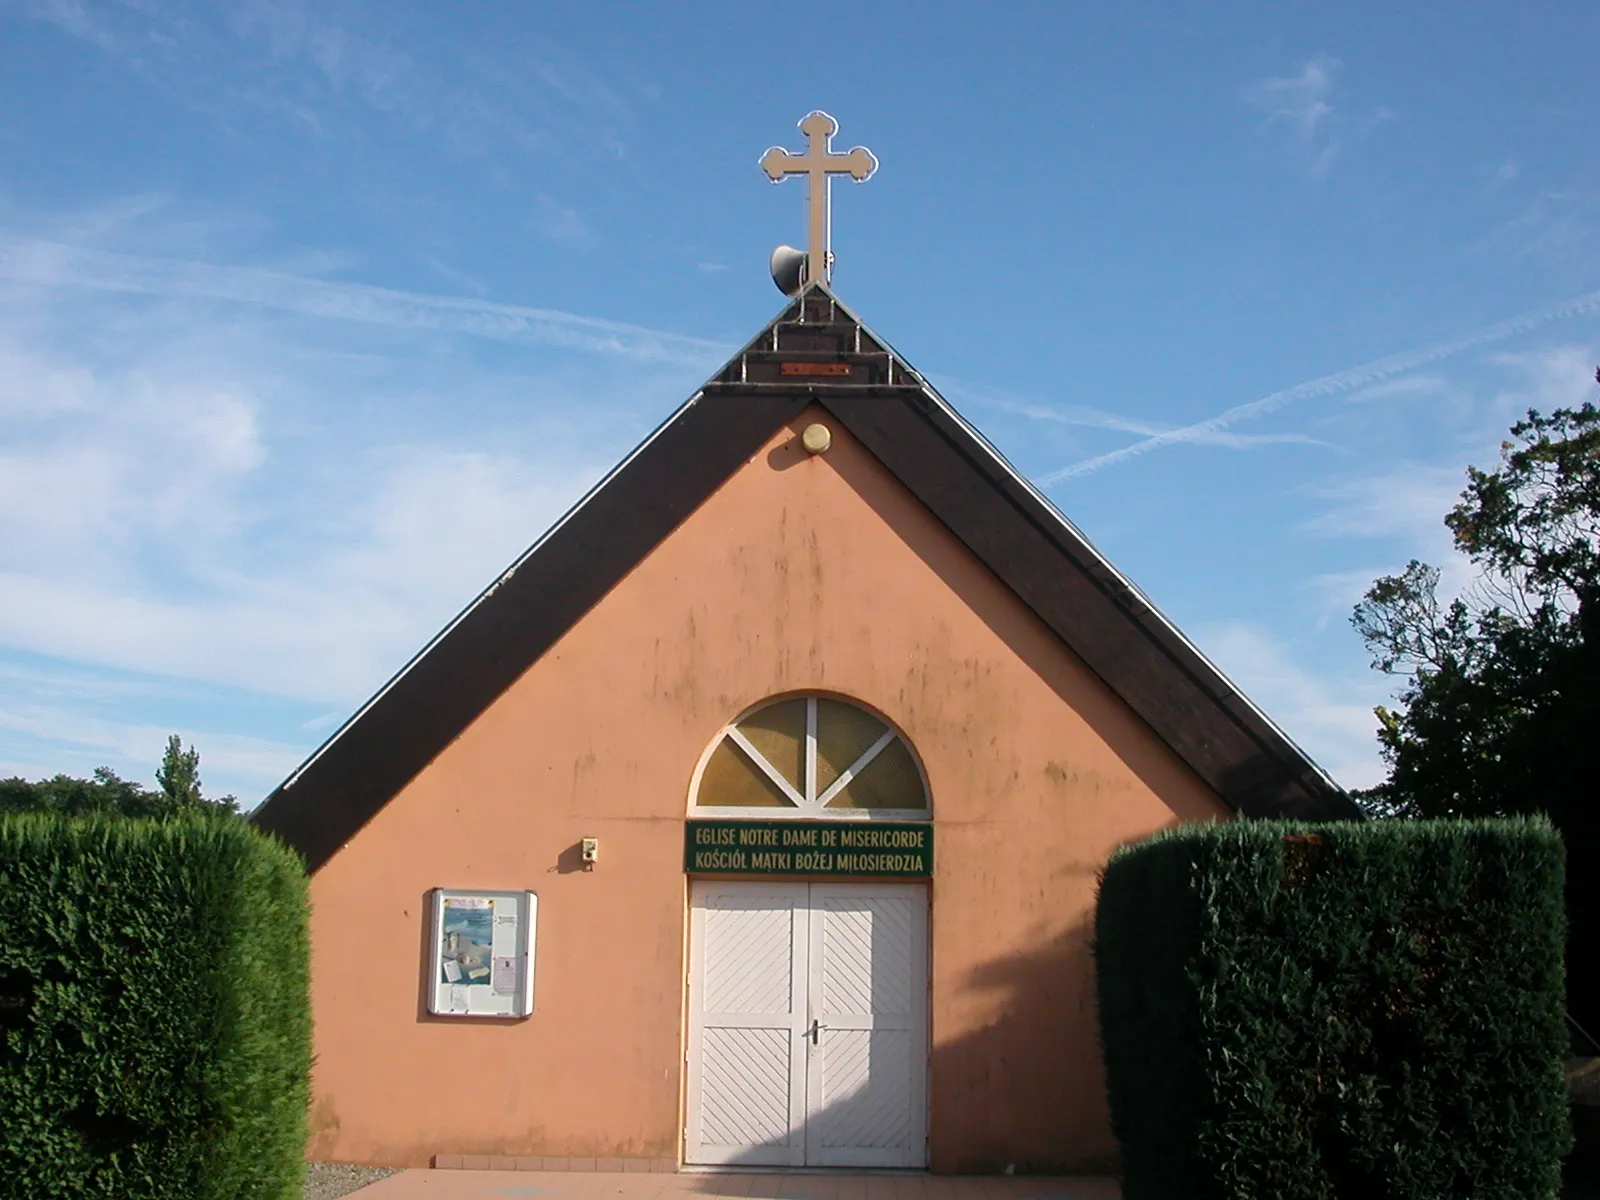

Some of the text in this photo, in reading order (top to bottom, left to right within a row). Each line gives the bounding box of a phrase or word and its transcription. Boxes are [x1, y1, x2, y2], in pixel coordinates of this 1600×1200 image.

[695, 828, 924, 848] EGLISE NOTRE DAME DE MISERICORDE
[695, 848, 924, 872] KOŚCIÓŁ MATKI BOŻEJ MIŁOSIERDZIA
